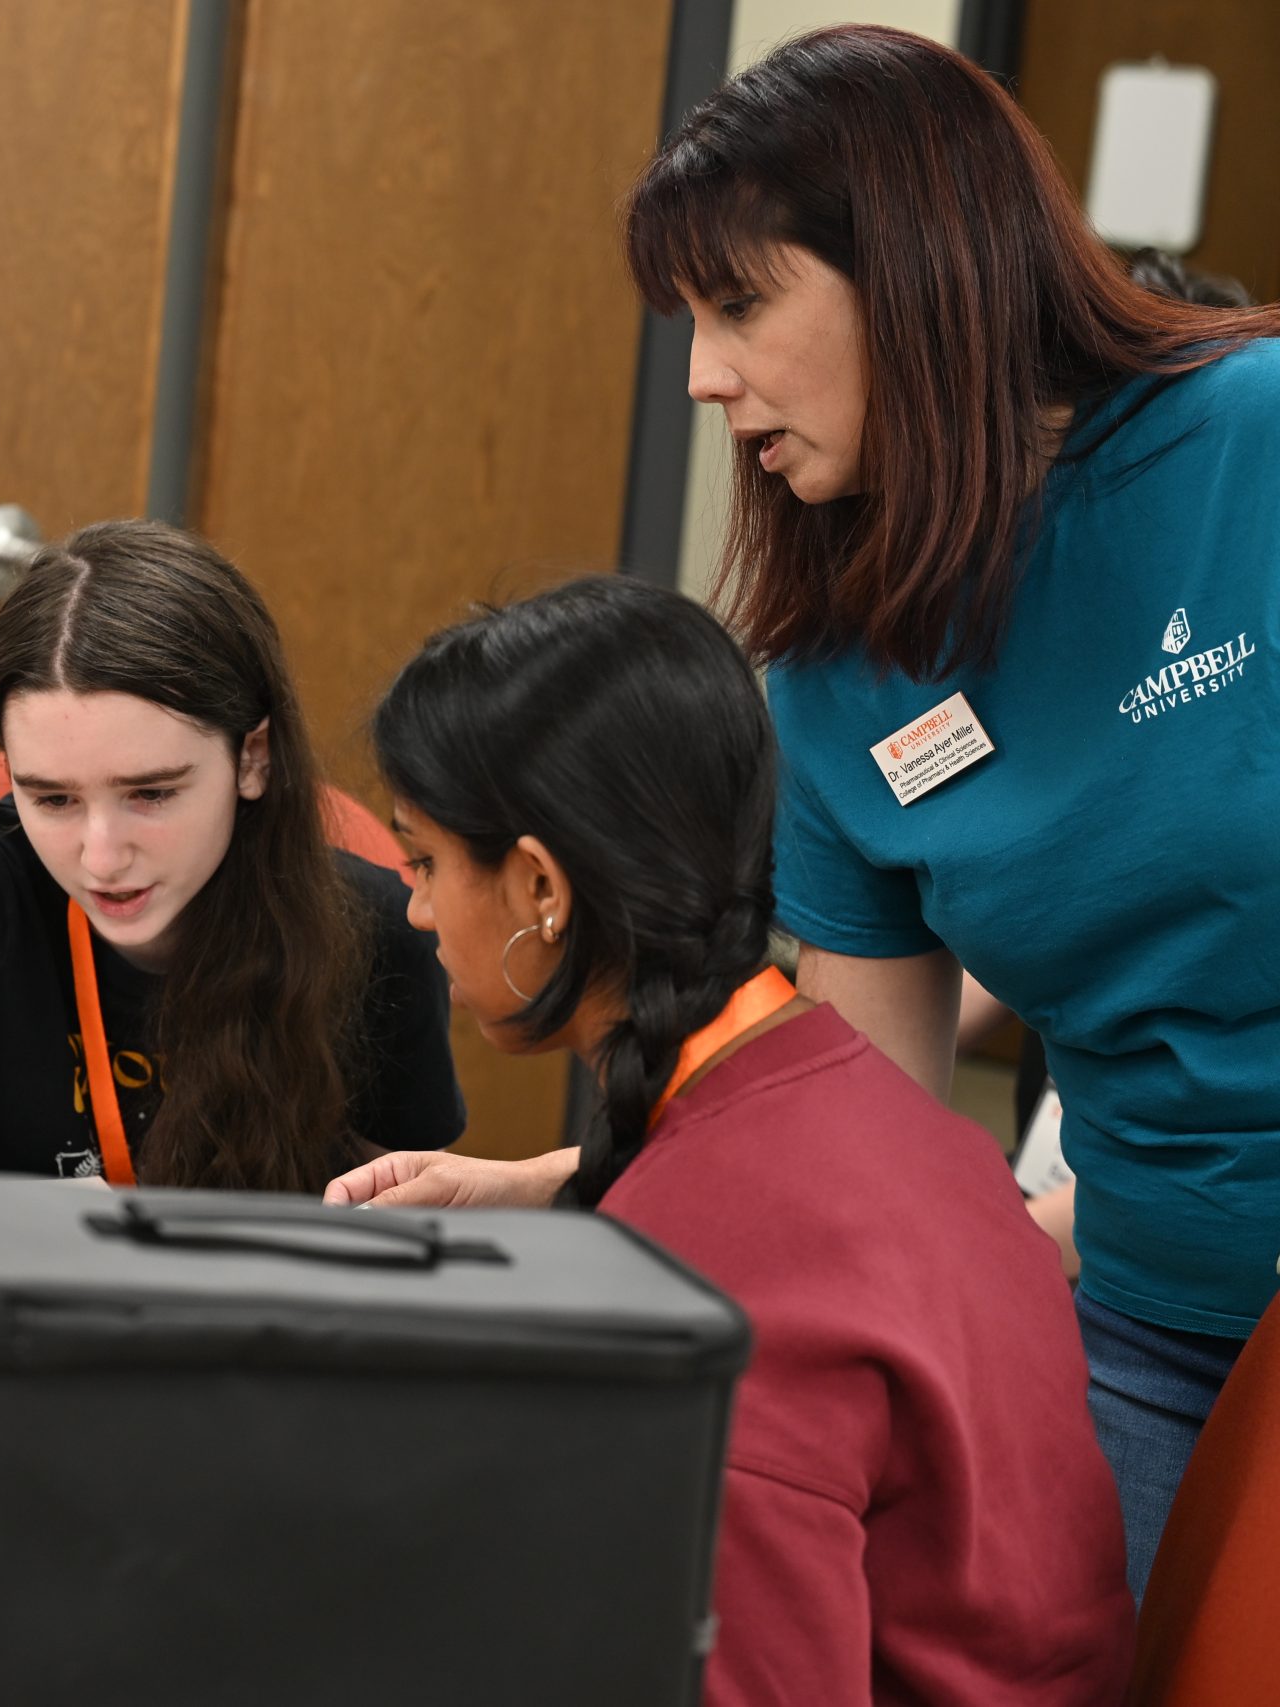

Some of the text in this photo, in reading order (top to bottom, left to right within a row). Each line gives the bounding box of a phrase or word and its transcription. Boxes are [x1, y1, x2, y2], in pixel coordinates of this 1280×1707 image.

[1118, 631, 1256, 714] CAMPBELL
[1131, 661, 1245, 724] UNIVERSITY
[887, 722, 975, 783] Dr. Vanessa Ayer Miller
[900, 708, 953, 748] CAMPBELL
[910, 721, 951, 751] UNIVERSITY
[898, 784, 918, 799] College
[917, 780, 923, 789] of
[921, 766, 947, 787] Pharmacy
[949, 754, 965, 768] Health
[964, 741, 987, 758] Sciences
[899, 763, 934, 789] Pharmaceutical
[938, 750, 957, 765] Clinical
[956, 737, 977, 754] Sciences
